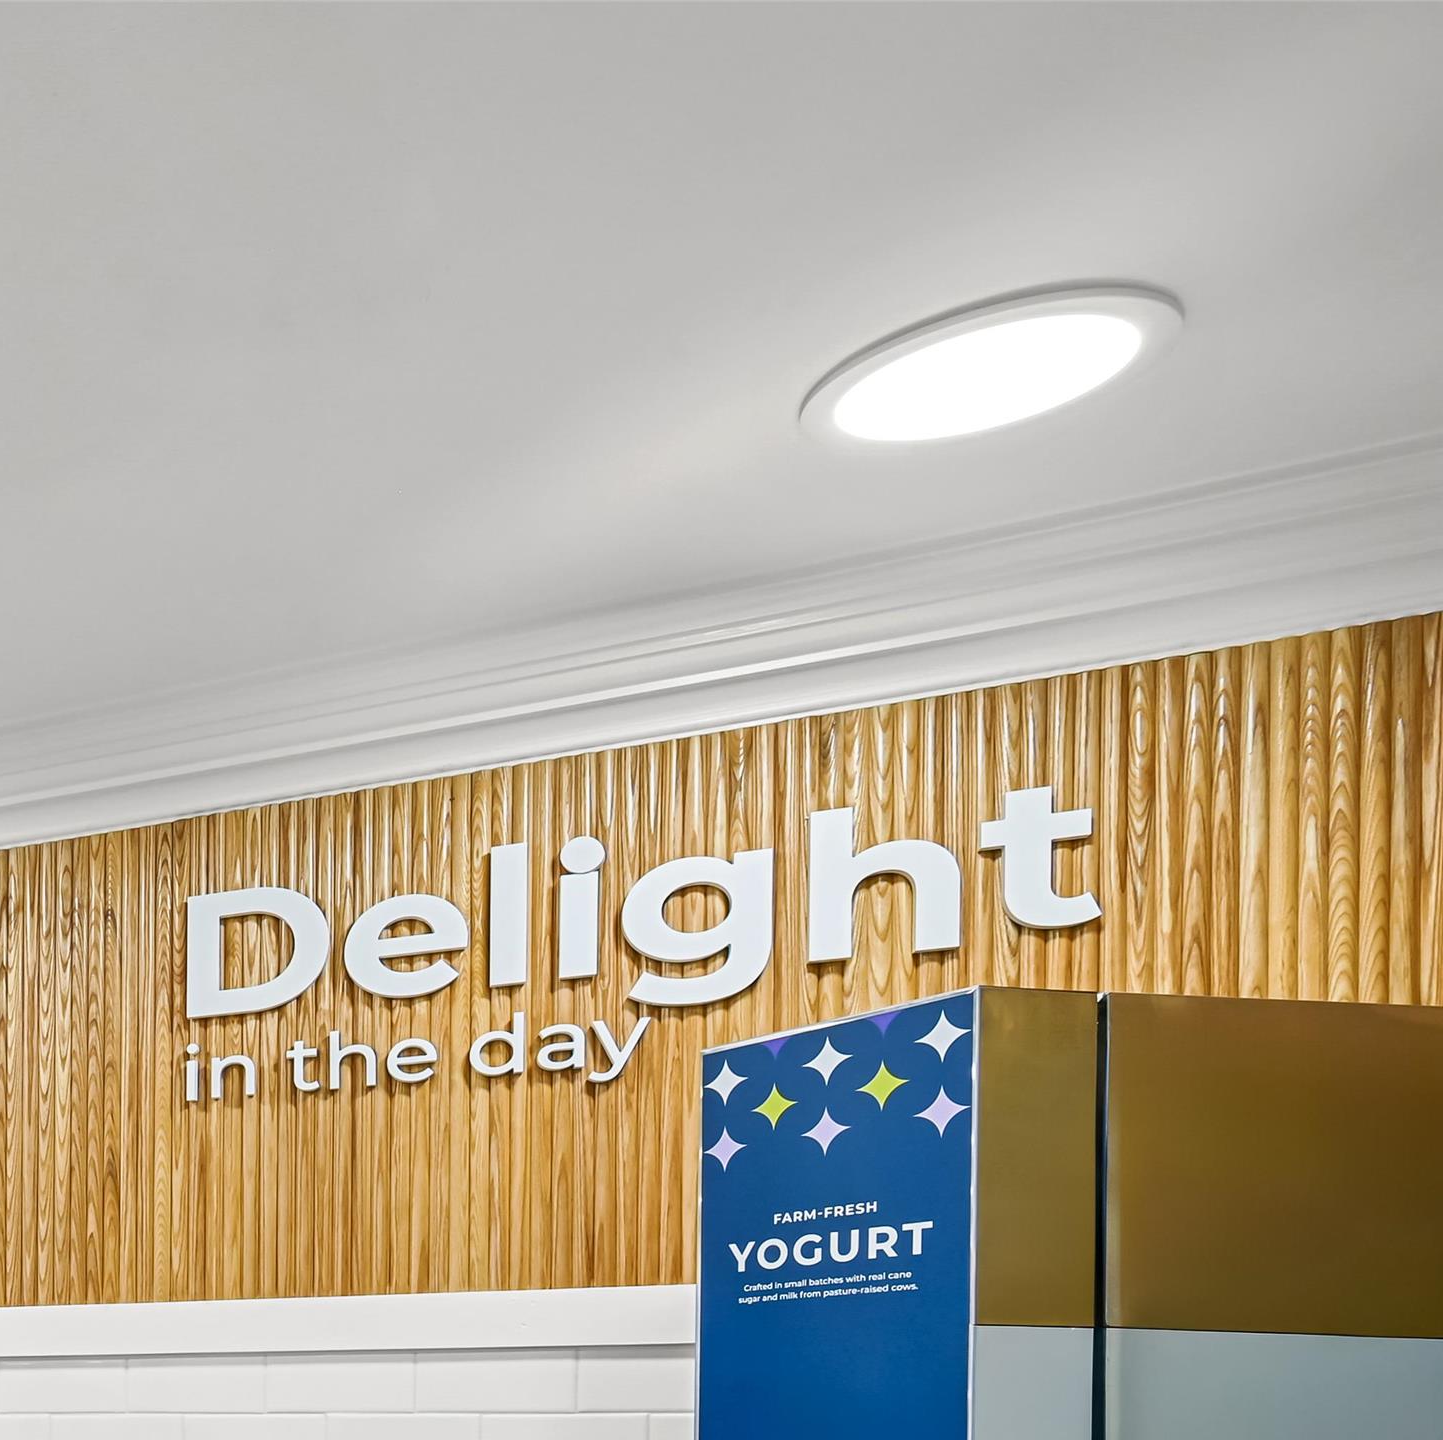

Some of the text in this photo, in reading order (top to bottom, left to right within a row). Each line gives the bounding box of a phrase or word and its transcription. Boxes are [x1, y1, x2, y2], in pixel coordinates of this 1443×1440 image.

[186, 786, 1102, 1020] Delight
[184, 1012, 651, 1102] in the day
[772, 1201, 878, 1225] FARM-FRESH
[728, 1220, 934, 1273] YOGURT
[738, 1282, 919, 1305] sugar and milk from pasture-raised cows.
[743, 1270, 912, 1293] Crafted in small batches with real cane
